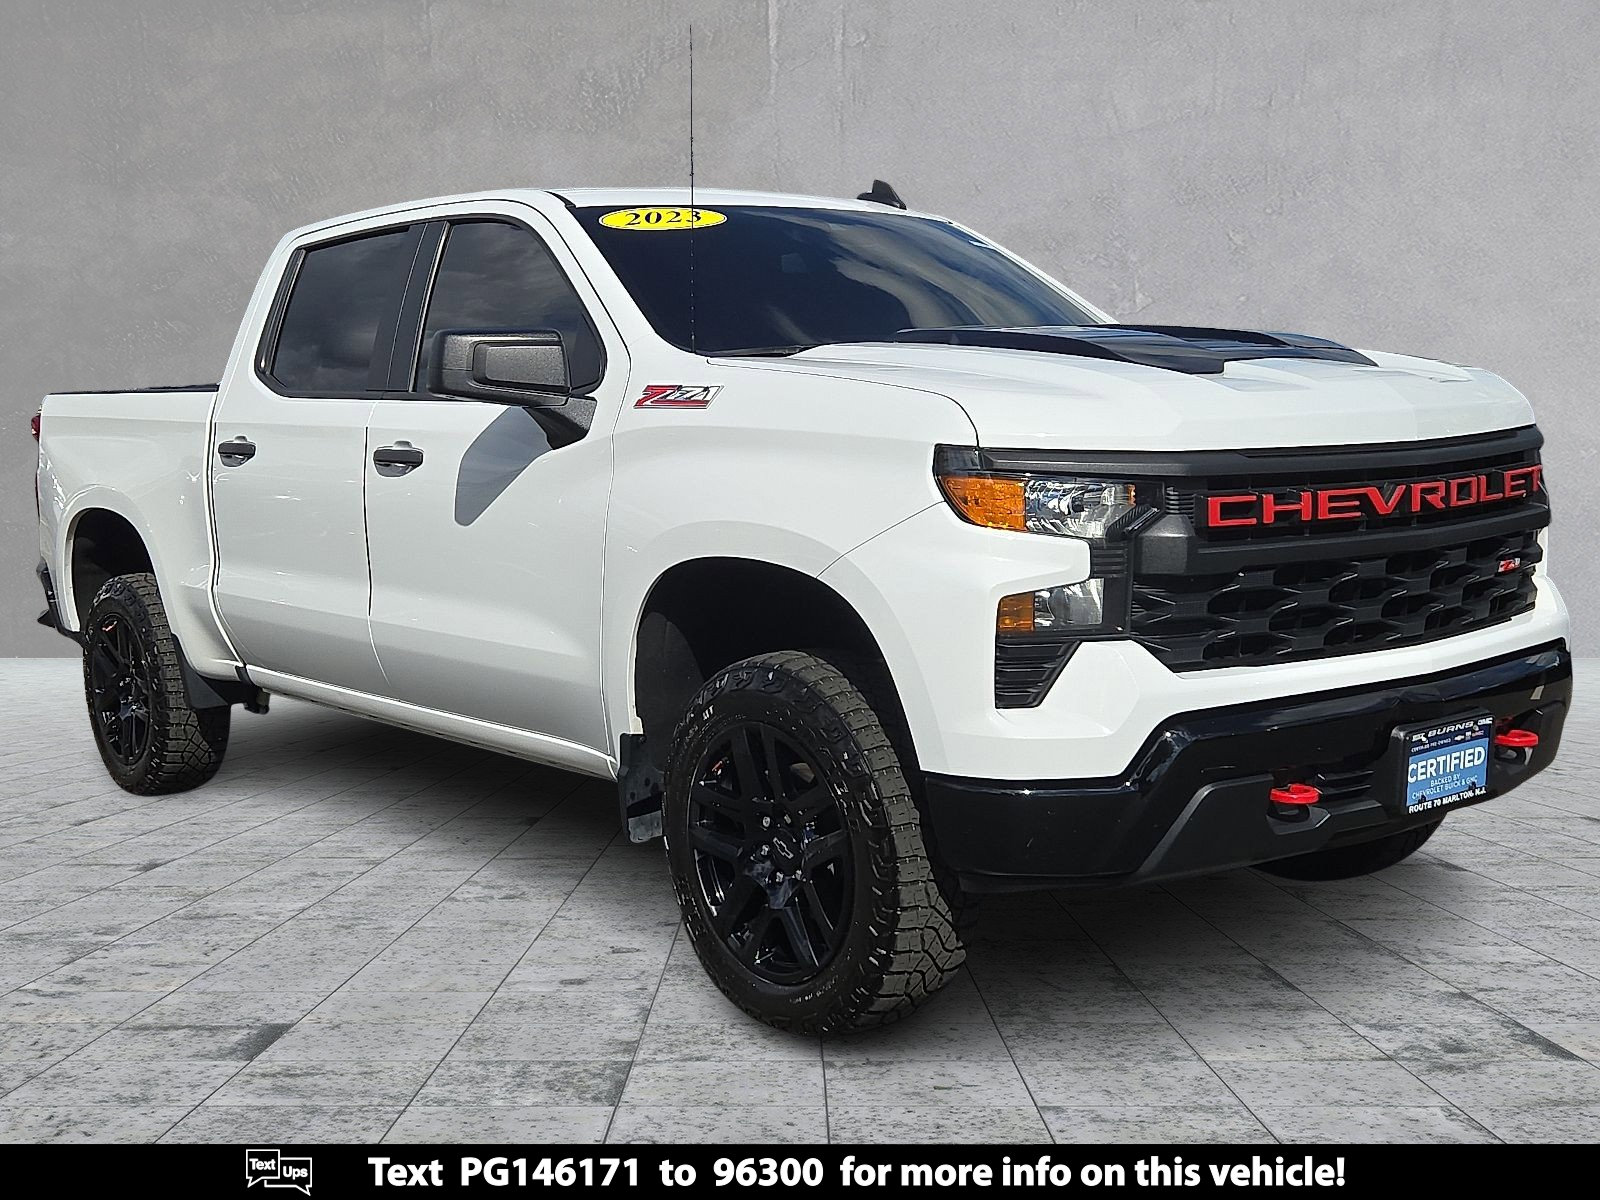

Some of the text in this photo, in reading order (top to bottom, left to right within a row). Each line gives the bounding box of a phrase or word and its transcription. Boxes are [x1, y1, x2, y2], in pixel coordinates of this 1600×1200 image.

[625, 210, 702, 228] 2023
[633, 384, 724, 410] Z71
[1208, 464, 1543, 527] CHEVROLET
[1428, 720, 1474, 737] BURNS
[1407, 746, 1487, 783] CERTIFIED
[1411, 784, 1444, 800] CHEVROLET
[1444, 780, 1461, 791] BUICK
[1430, 773, 1461, 788] BACKED BY
[1408, 799, 1433, 815] ROUTE
[1433, 798, 1442, 808] 70
